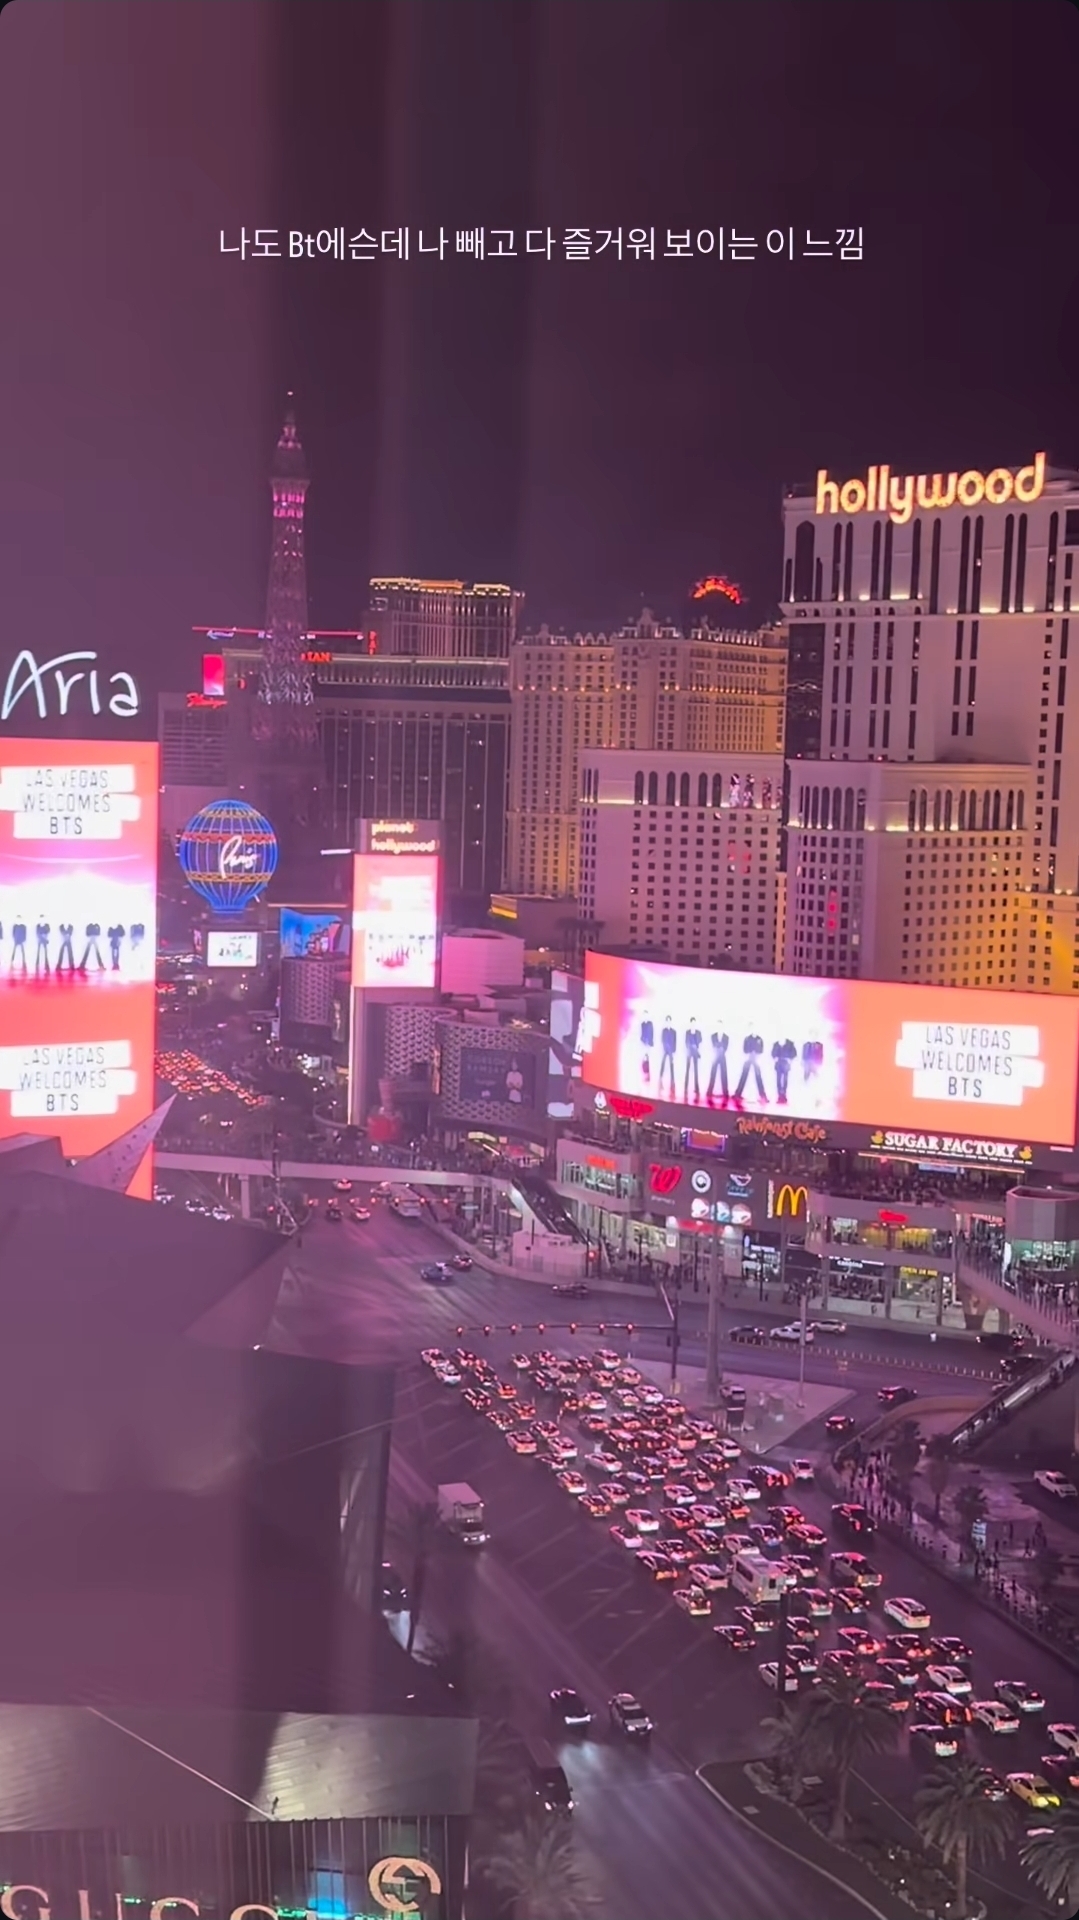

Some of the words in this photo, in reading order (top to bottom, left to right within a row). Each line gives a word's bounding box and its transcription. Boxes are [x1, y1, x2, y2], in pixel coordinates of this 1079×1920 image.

[815, 452, 1045, 524] hollywood
[1, 650, 139, 720] Aria
[60, 769, 109, 789] VEGAS
[23, 792, 111, 813] WELCOMES
[49, 816, 83, 835] BTS
[925, 1025, 954, 1046] LAS
[960, 1027, 1011, 1051] VEGAS
[56, 1046, 105, 1066] VEGAS
[921, 1049, 1012, 1077] WELCOMES
[19, 1070, 107, 1091] WELCOMES
[948, 1076, 982, 1098] BTS
[46, 1093, 79, 1112] BTS
[885, 1131, 939, 1152] SUGAR
[942, 1136, 1018, 1159] FACTORY
